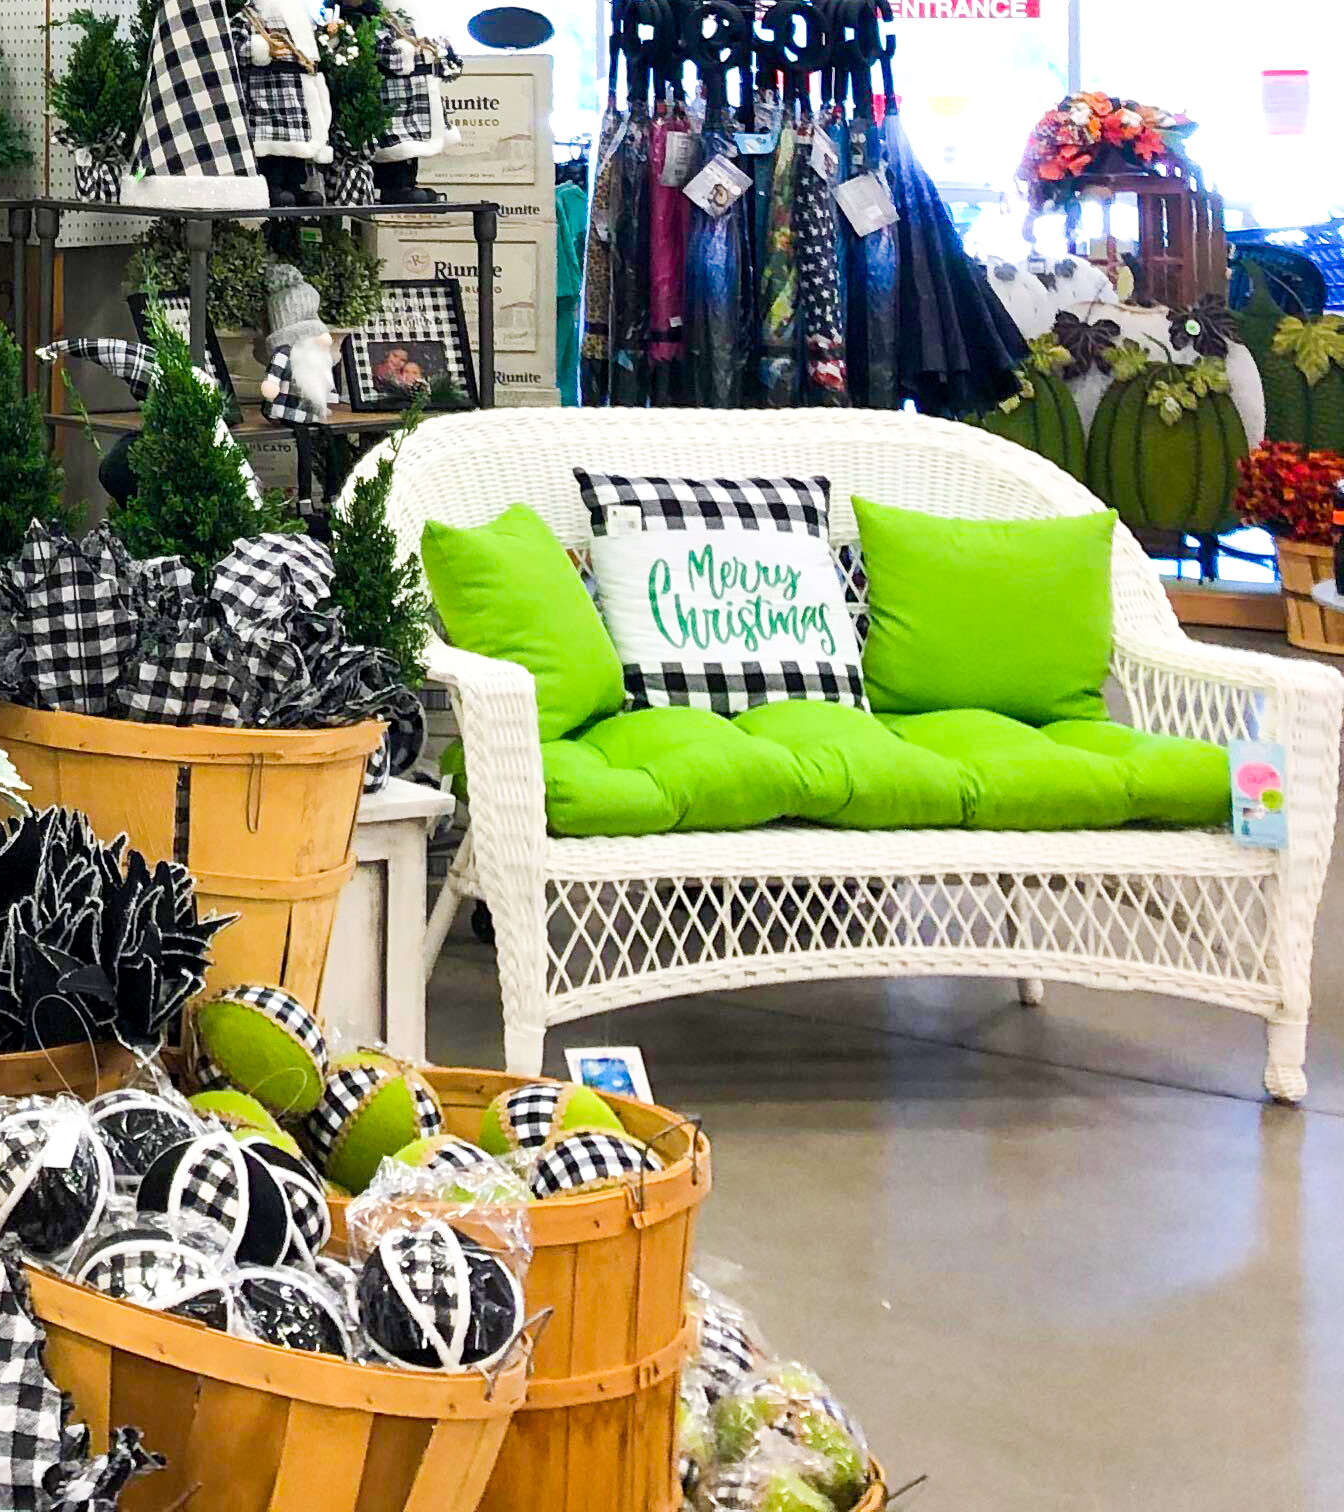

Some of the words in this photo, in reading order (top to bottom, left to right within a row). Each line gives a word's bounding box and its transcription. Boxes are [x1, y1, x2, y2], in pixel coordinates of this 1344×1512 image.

[441, 95, 500, 115] iunite
[450, 118, 500, 128] BRUSCO
[433, 261, 503, 281] Riune
[687, 543, 802, 602] Merry
[648, 557, 837, 657] Christmas
